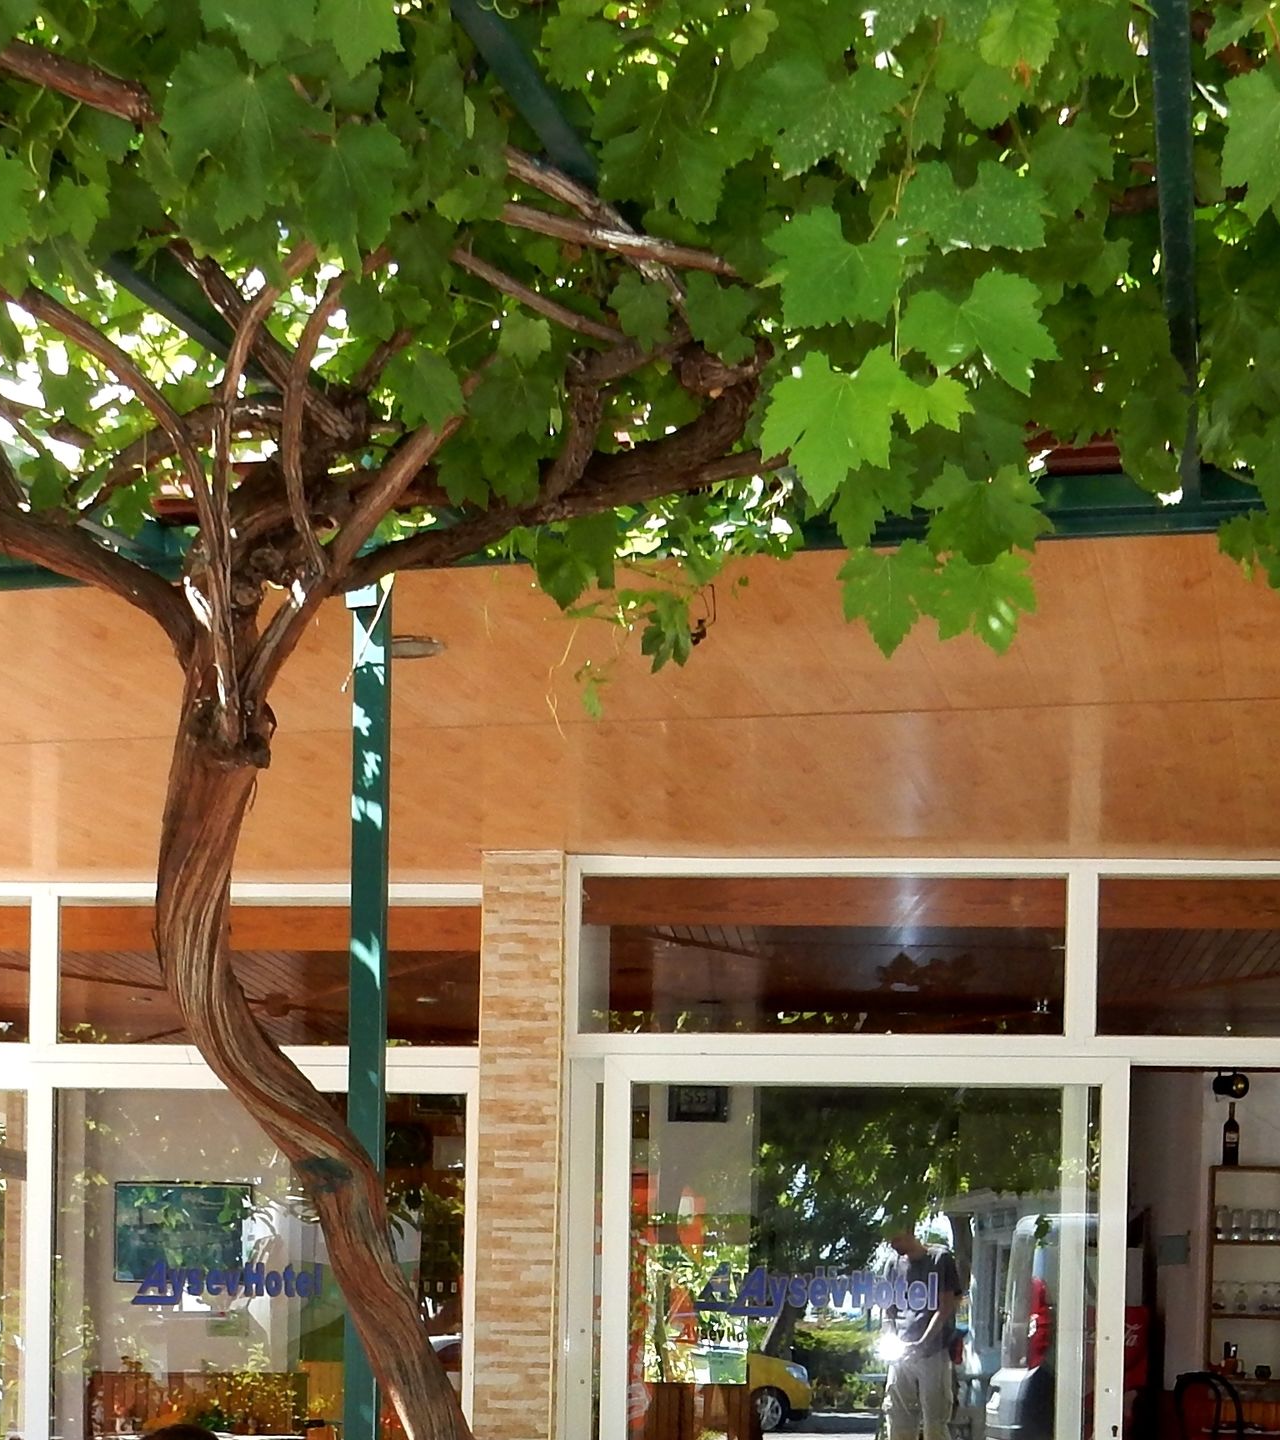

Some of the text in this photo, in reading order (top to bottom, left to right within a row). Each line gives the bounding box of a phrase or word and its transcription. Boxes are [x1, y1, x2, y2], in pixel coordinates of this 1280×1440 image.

[131, 1259, 323, 1305] Aysev Hotel
[851, 1270, 938, 1310] Hotel
